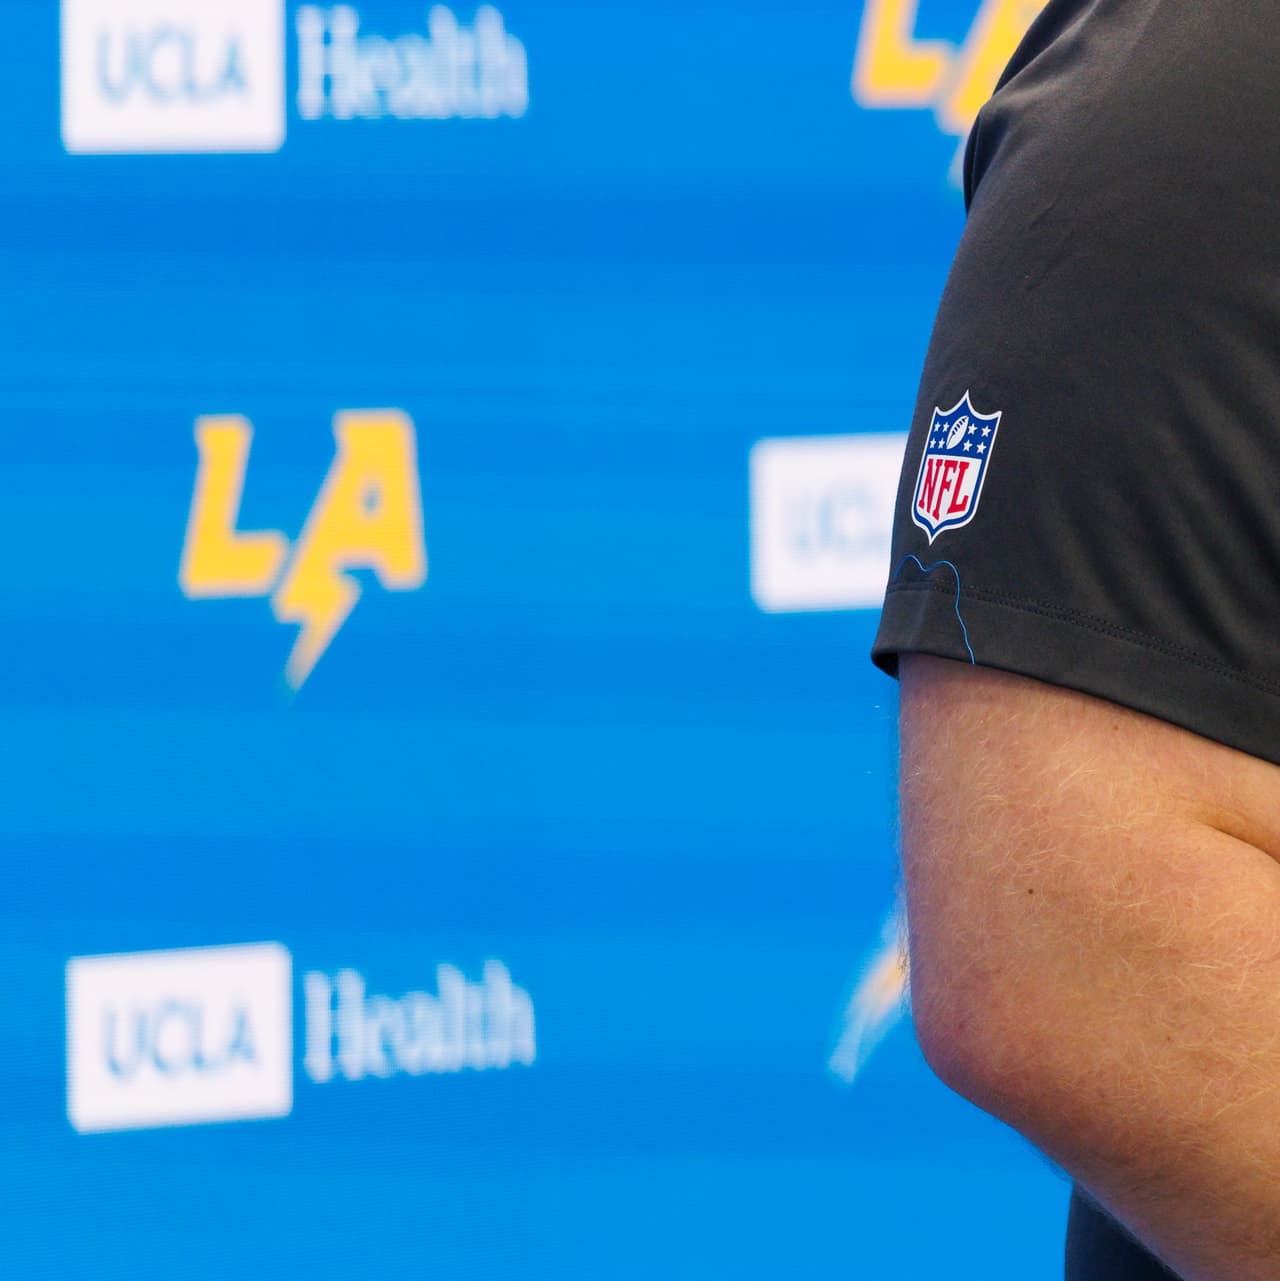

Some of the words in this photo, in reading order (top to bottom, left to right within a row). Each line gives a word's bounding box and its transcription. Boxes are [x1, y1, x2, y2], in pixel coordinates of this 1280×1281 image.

[95, 19, 250, 106] UCLA
[296, 4, 529, 119] Health
[917, 457, 976, 523] NFL
[180, 408, 428, 698] LA
[101, 998, 259, 1084] UCLA
[302, 958, 537, 1086] Health
